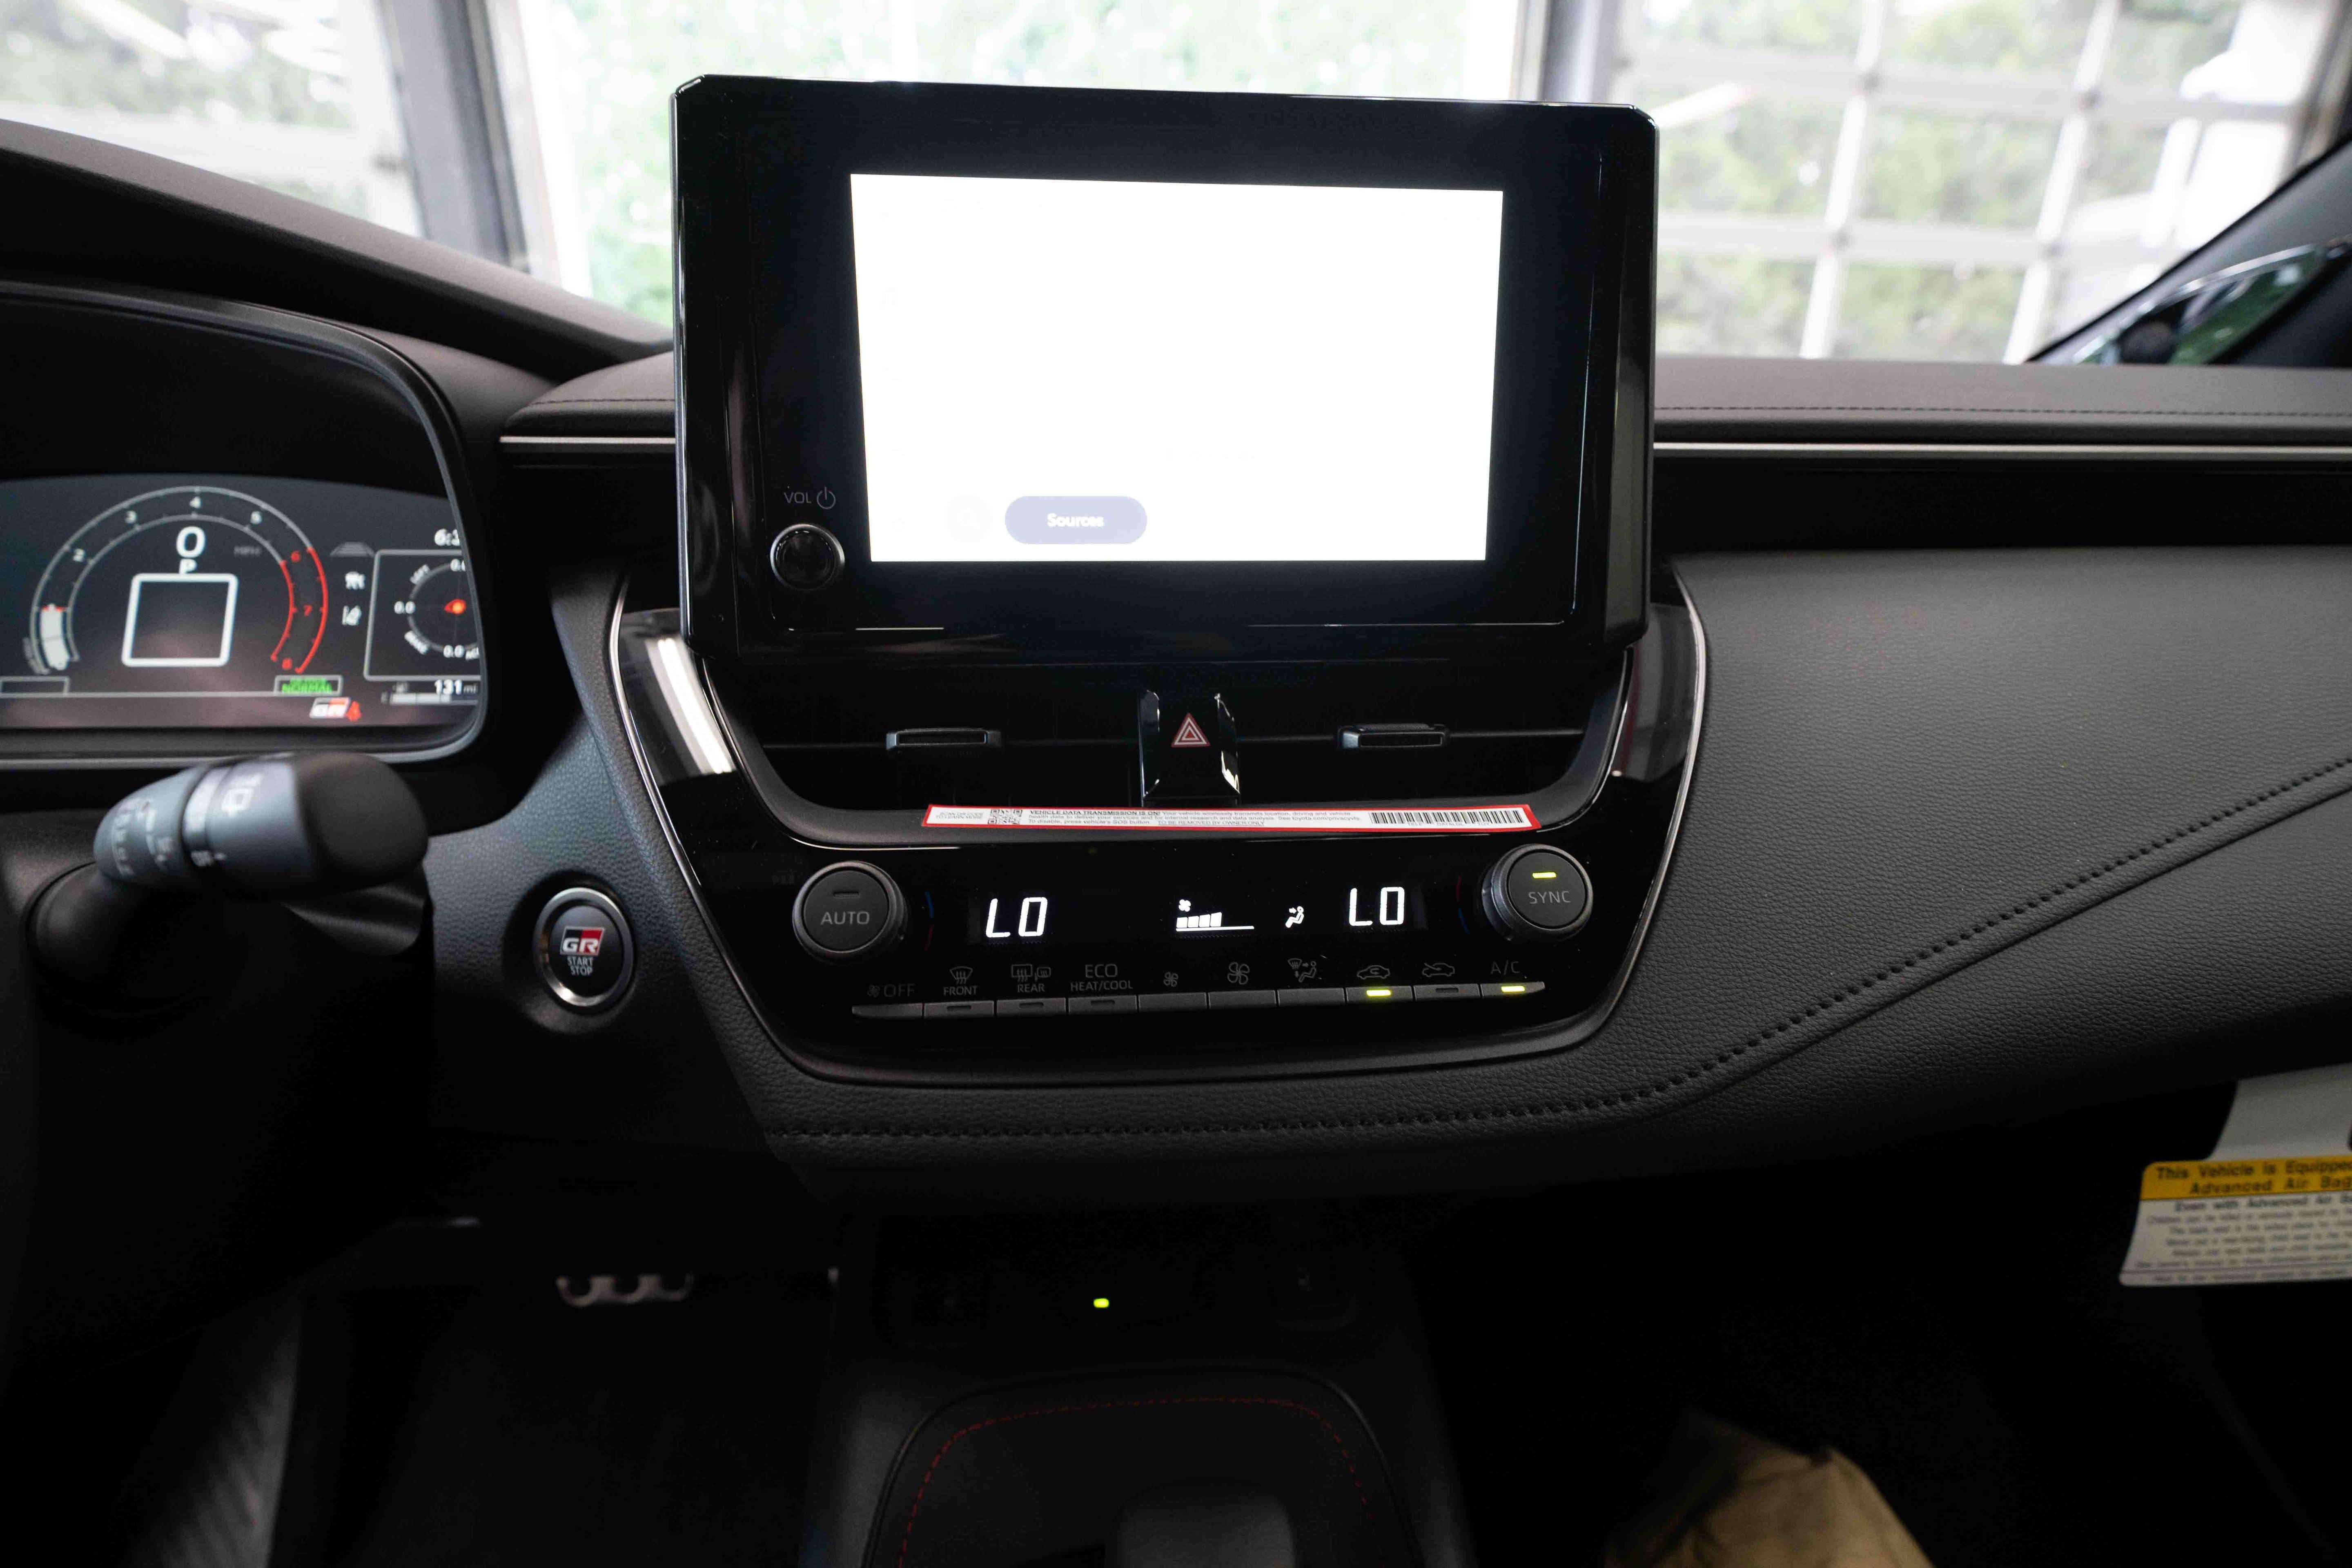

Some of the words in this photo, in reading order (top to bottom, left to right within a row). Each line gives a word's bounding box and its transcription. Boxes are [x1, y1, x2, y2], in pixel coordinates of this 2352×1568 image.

[784, 492, 812, 503] VOL
[1047, 513, 1105, 527] Sources
[179, 558, 198, 574] P
[304, 604, 313, 617] 7
[434, 679, 462, 694] 131
[1528, 890, 1572, 904] SYNC
[820, 911, 870, 926] AUTO
[562, 938, 599, 953] GR
[567, 957, 594, 967] START
[1490, 961, 1520, 974] A/C
[571, 966, 593, 976] STOP
[1085, 964, 1118, 978] ECO
[883, 983, 916, 998] OFF
[943, 985, 978, 996] FRONT
[1017, 983, 1045, 993] REAR
[1070, 980, 1134, 992] HEAT/COOL
[2156, 1165, 2189, 1180] This
[2198, 1163, 2255, 1177] Vehicle
[2190, 1180, 2272, 1194] Advanced
[2284, 1177, 2309, 1190] Air
